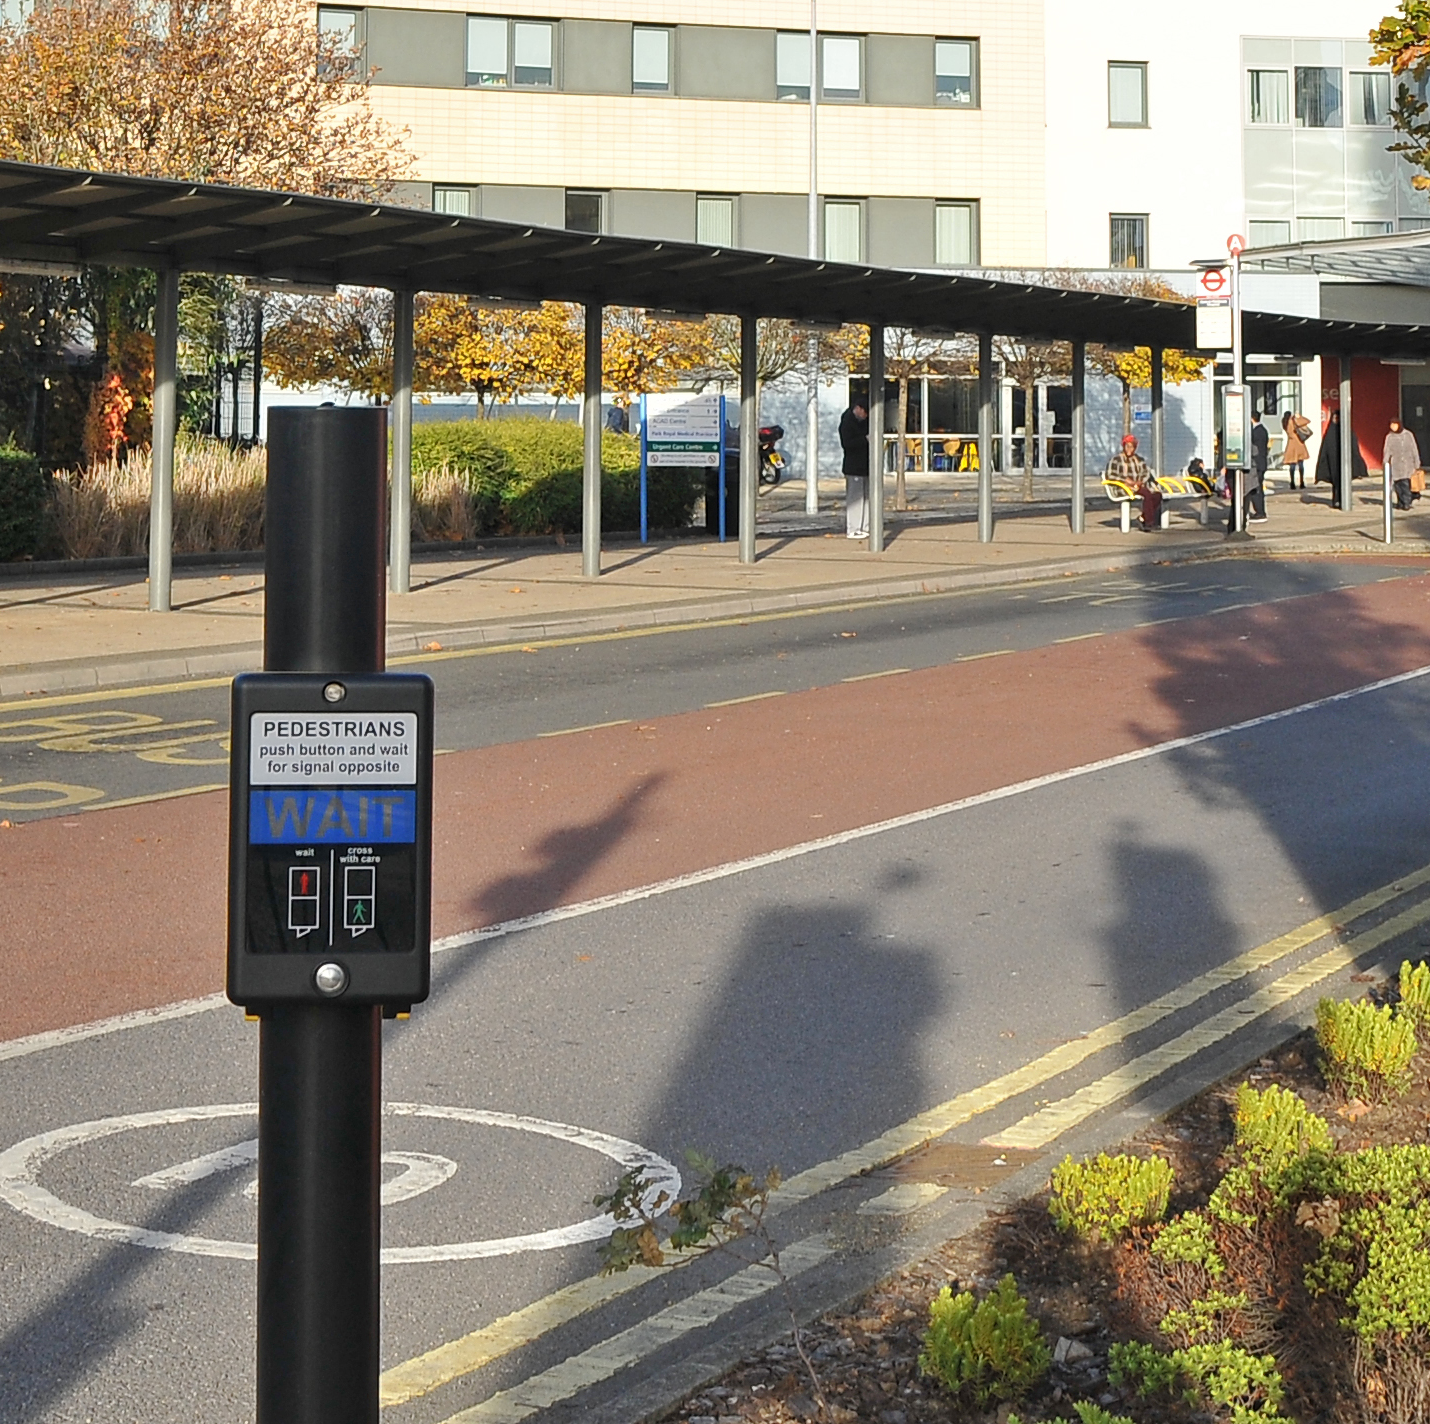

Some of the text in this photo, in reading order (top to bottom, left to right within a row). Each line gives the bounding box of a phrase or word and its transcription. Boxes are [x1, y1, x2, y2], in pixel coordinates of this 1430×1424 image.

[1228, 235, 1242, 251] A
[263, 721, 406, 737] PEDESTRIANS
[259, 743, 409, 759] push button and wait
[267, 760, 400, 776] for signal opposite
[264, 796, 405, 839] WAIT
[294, 848, 315, 857] wait
[339, 854, 381, 863] with care
[347, 847, 373, 855] cross
